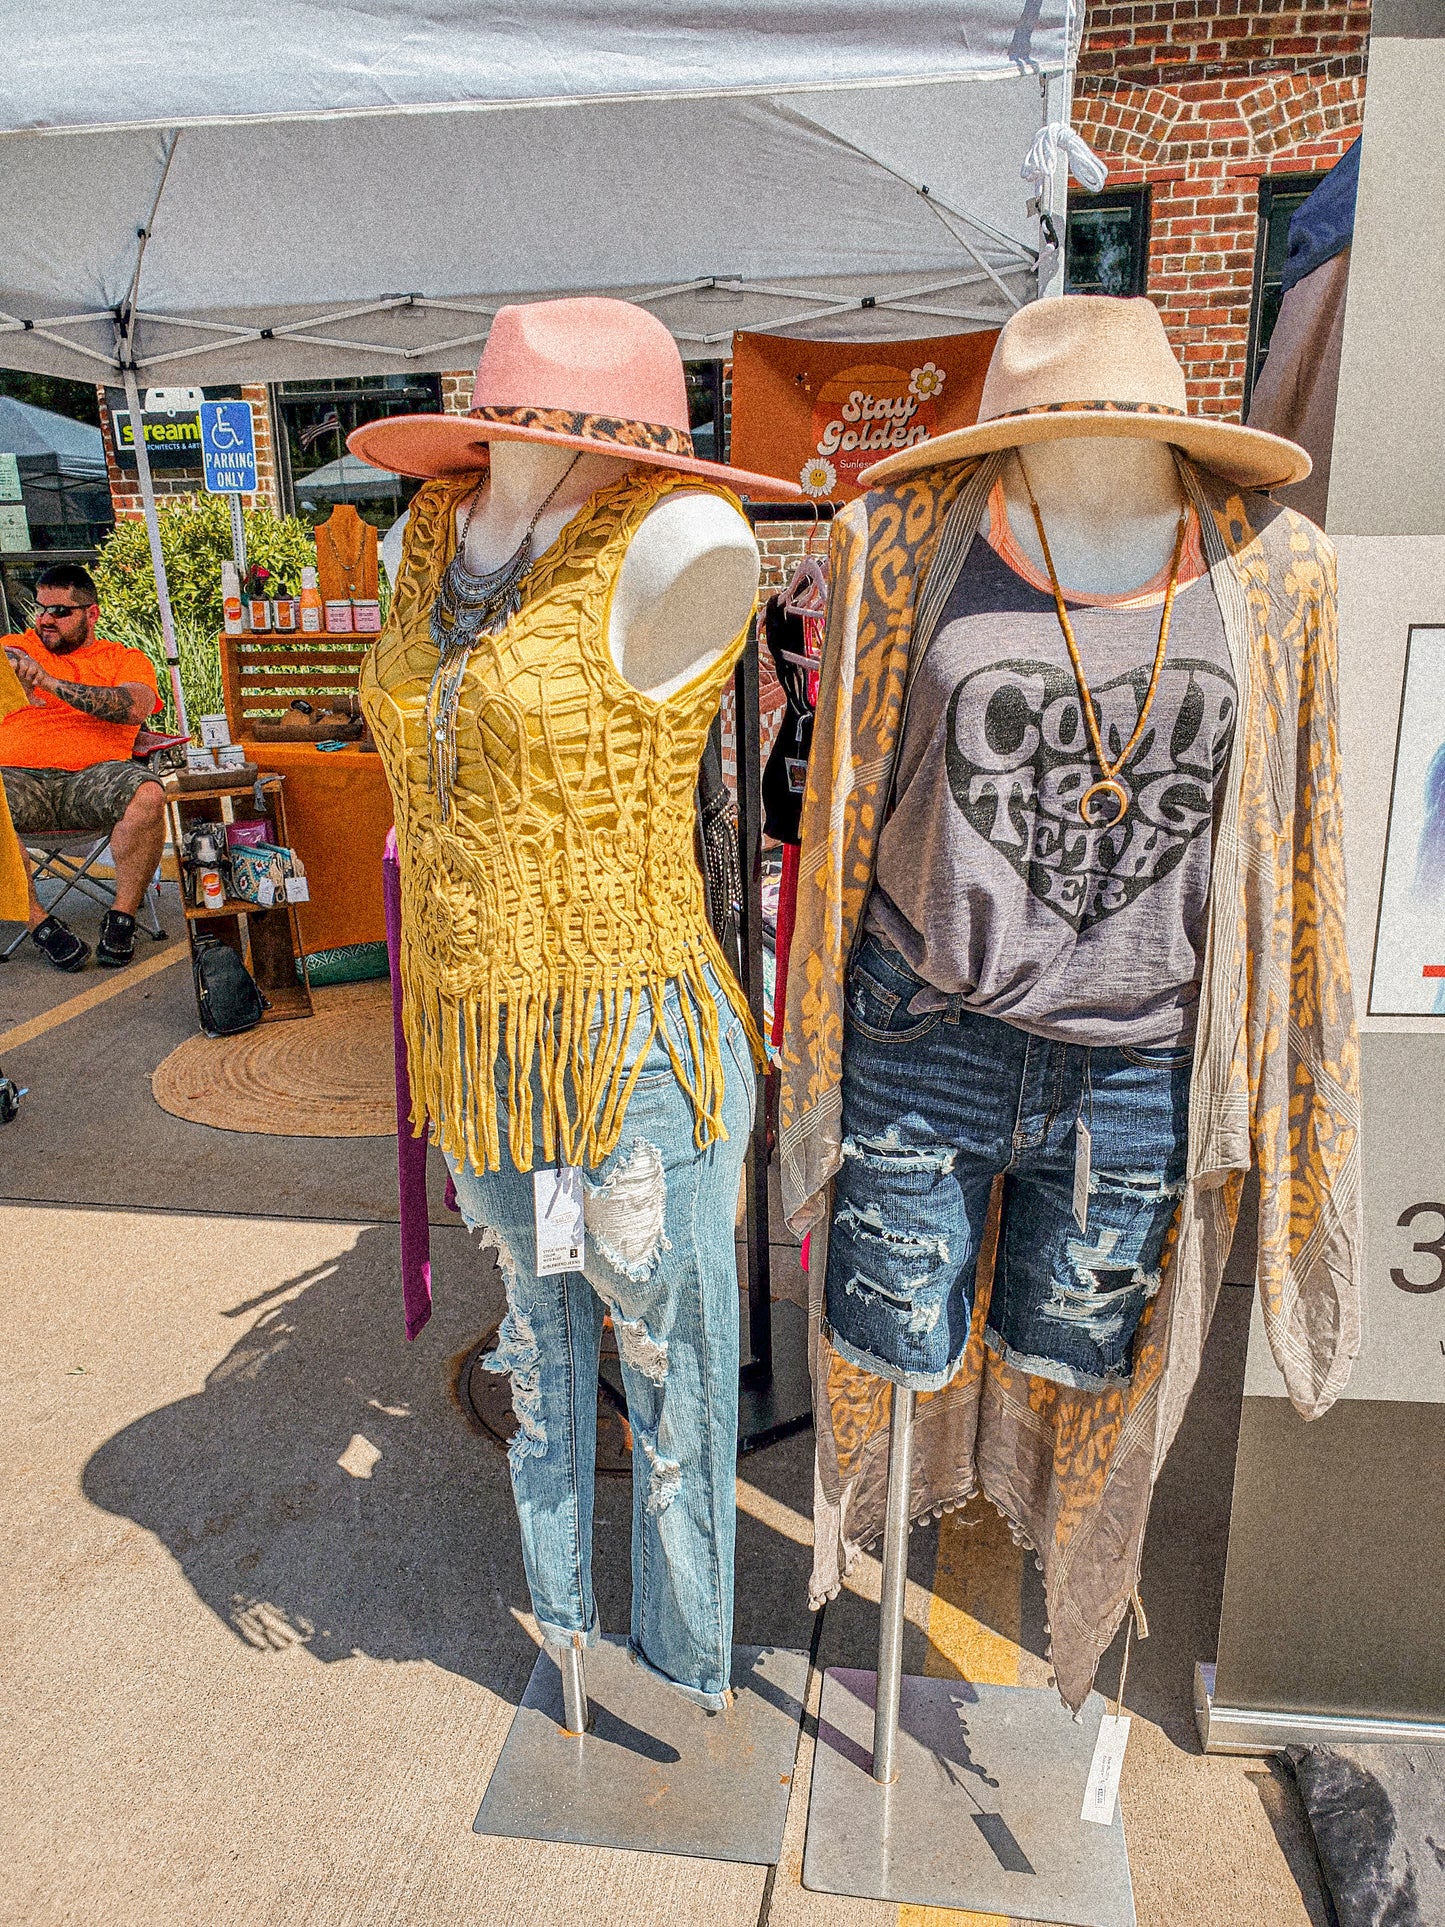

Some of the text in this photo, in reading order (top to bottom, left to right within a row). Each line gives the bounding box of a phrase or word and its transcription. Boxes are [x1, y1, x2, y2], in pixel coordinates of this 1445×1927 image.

[841, 390, 919, 427] Stay
[816, 420, 930, 456] Golden
[206, 452, 254, 469] PARKING
[216, 471, 245, 488] ONLY
